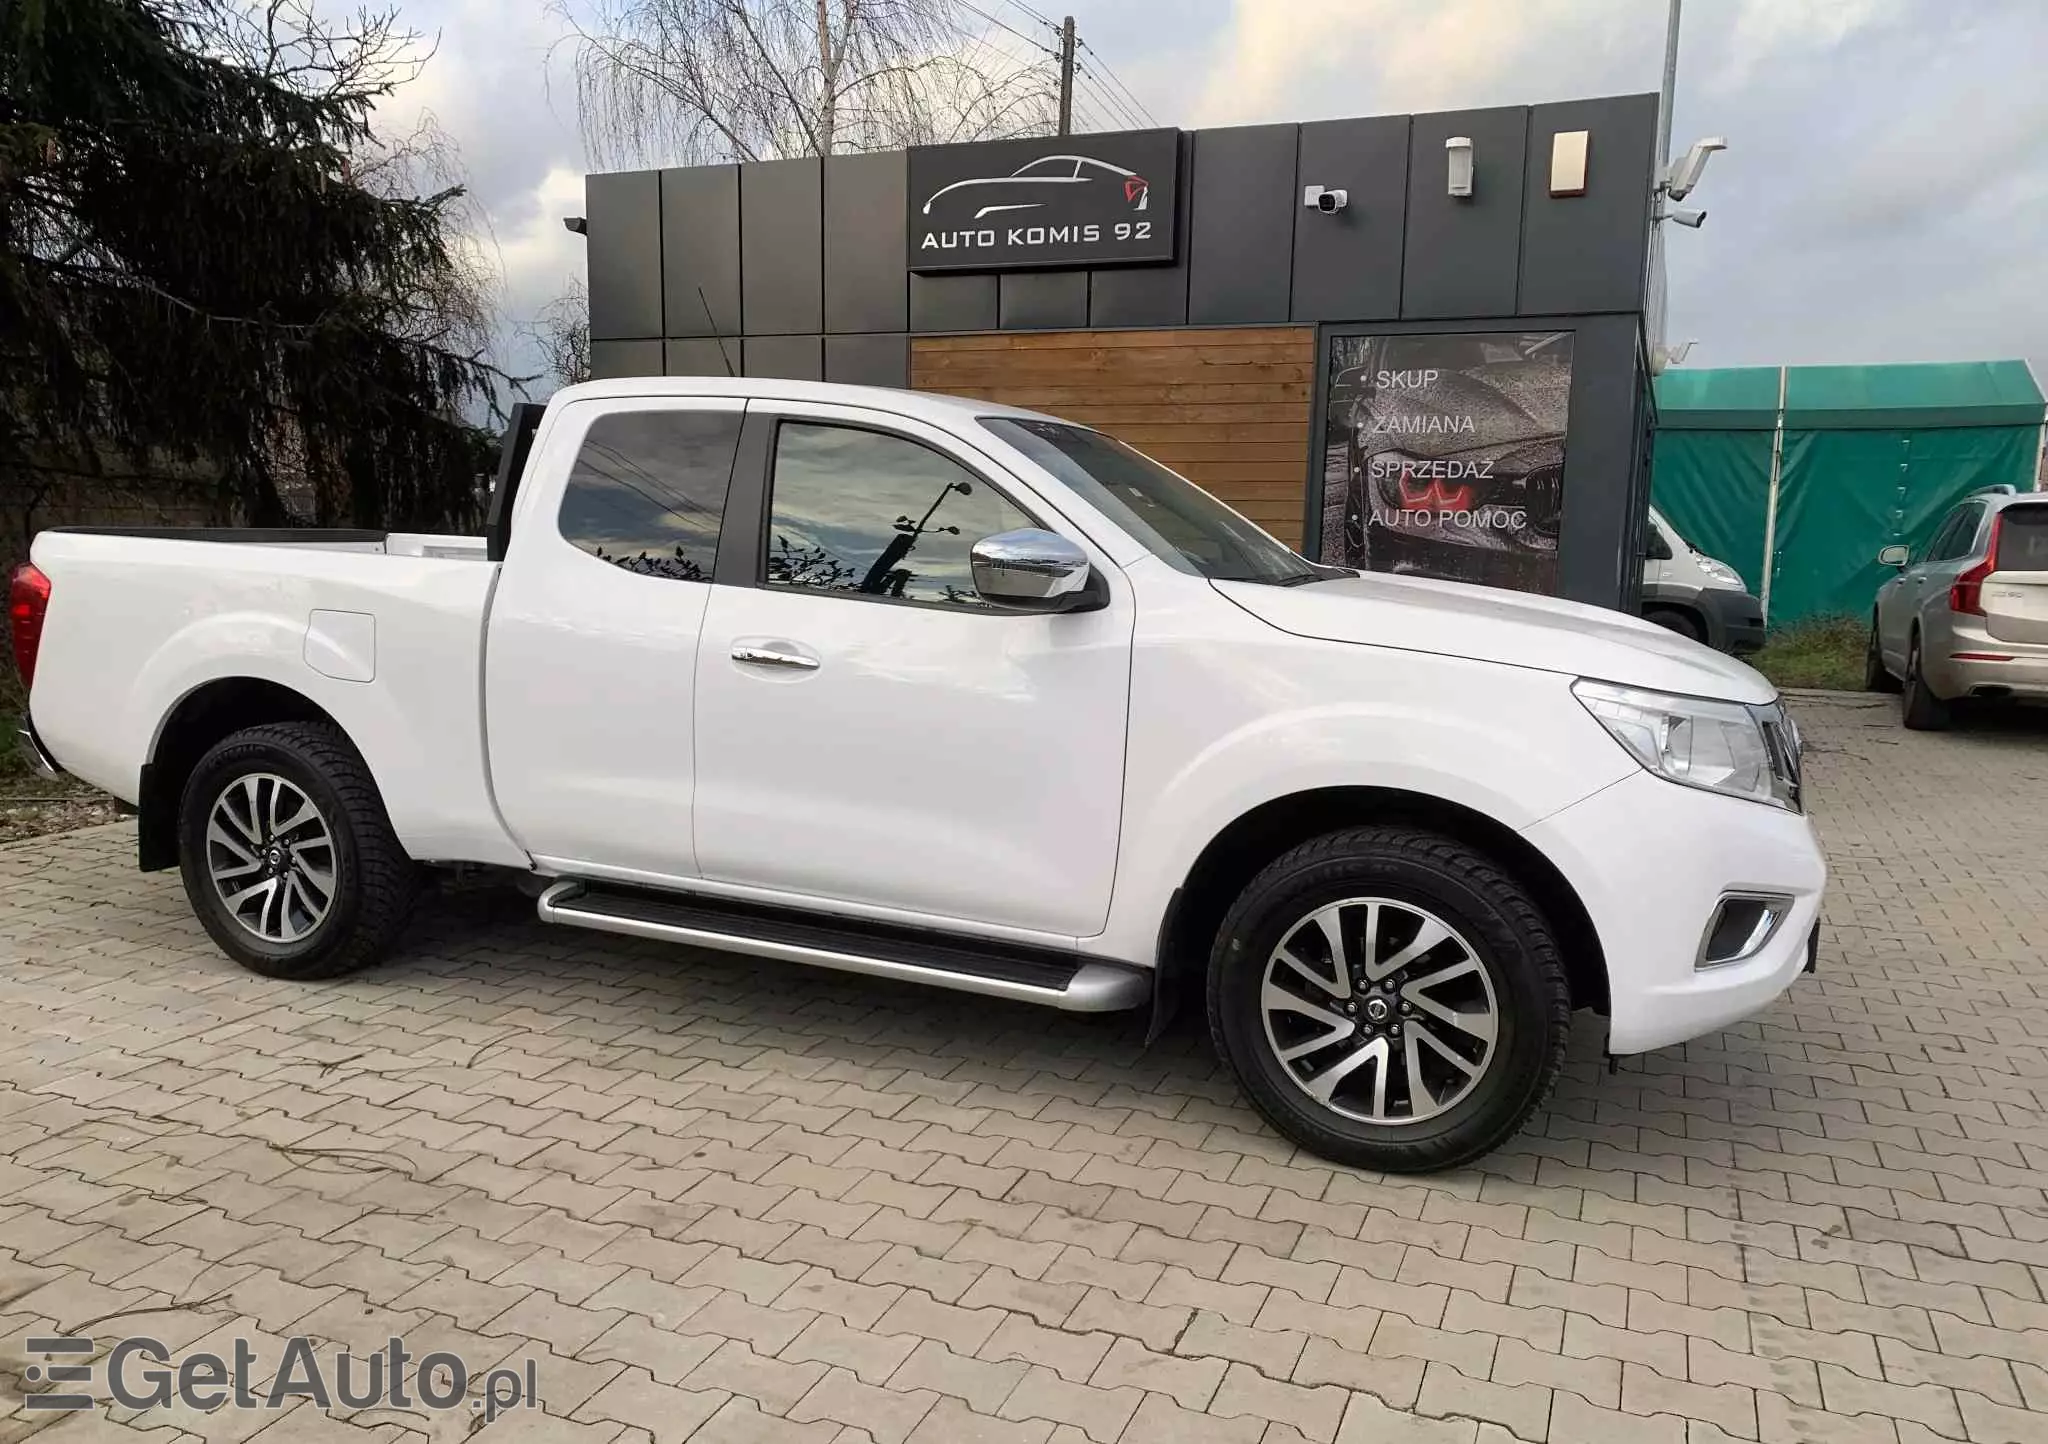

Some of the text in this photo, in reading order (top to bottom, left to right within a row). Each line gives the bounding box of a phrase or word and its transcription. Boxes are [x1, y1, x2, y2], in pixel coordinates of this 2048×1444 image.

[921, 221, 1152, 250] AUTO KOMIS 92
[1376, 369, 1439, 389] SKUP
[1372, 415, 1476, 434] ZAMIANA
[1368, 509, 1528, 529] AUTO POMOC
